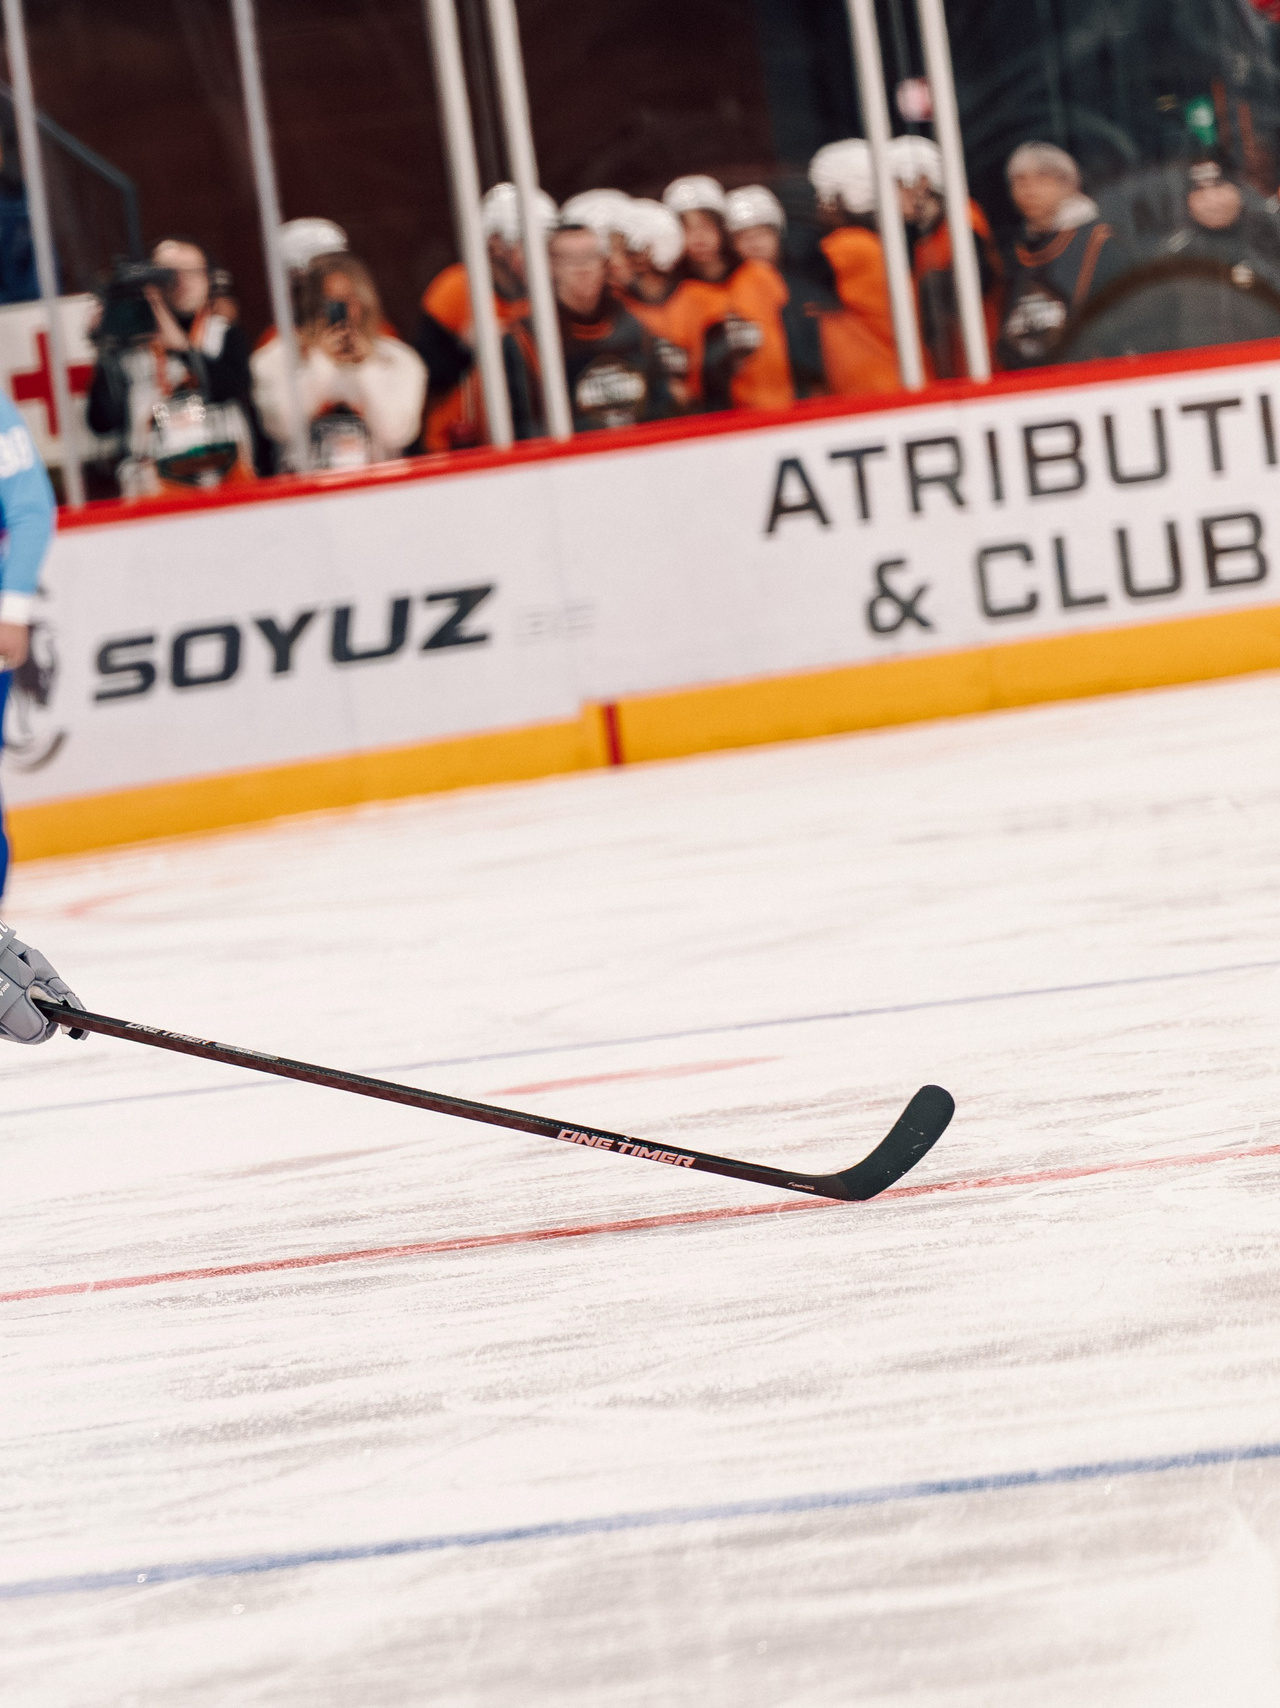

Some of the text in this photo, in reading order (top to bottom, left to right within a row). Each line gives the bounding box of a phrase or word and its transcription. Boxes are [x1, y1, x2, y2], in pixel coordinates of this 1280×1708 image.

[866, 511, 1269, 637] & CLUB
[92, 581, 496, 704] SOYUZ
[556, 1128, 696, 1168] ONE TIMER
